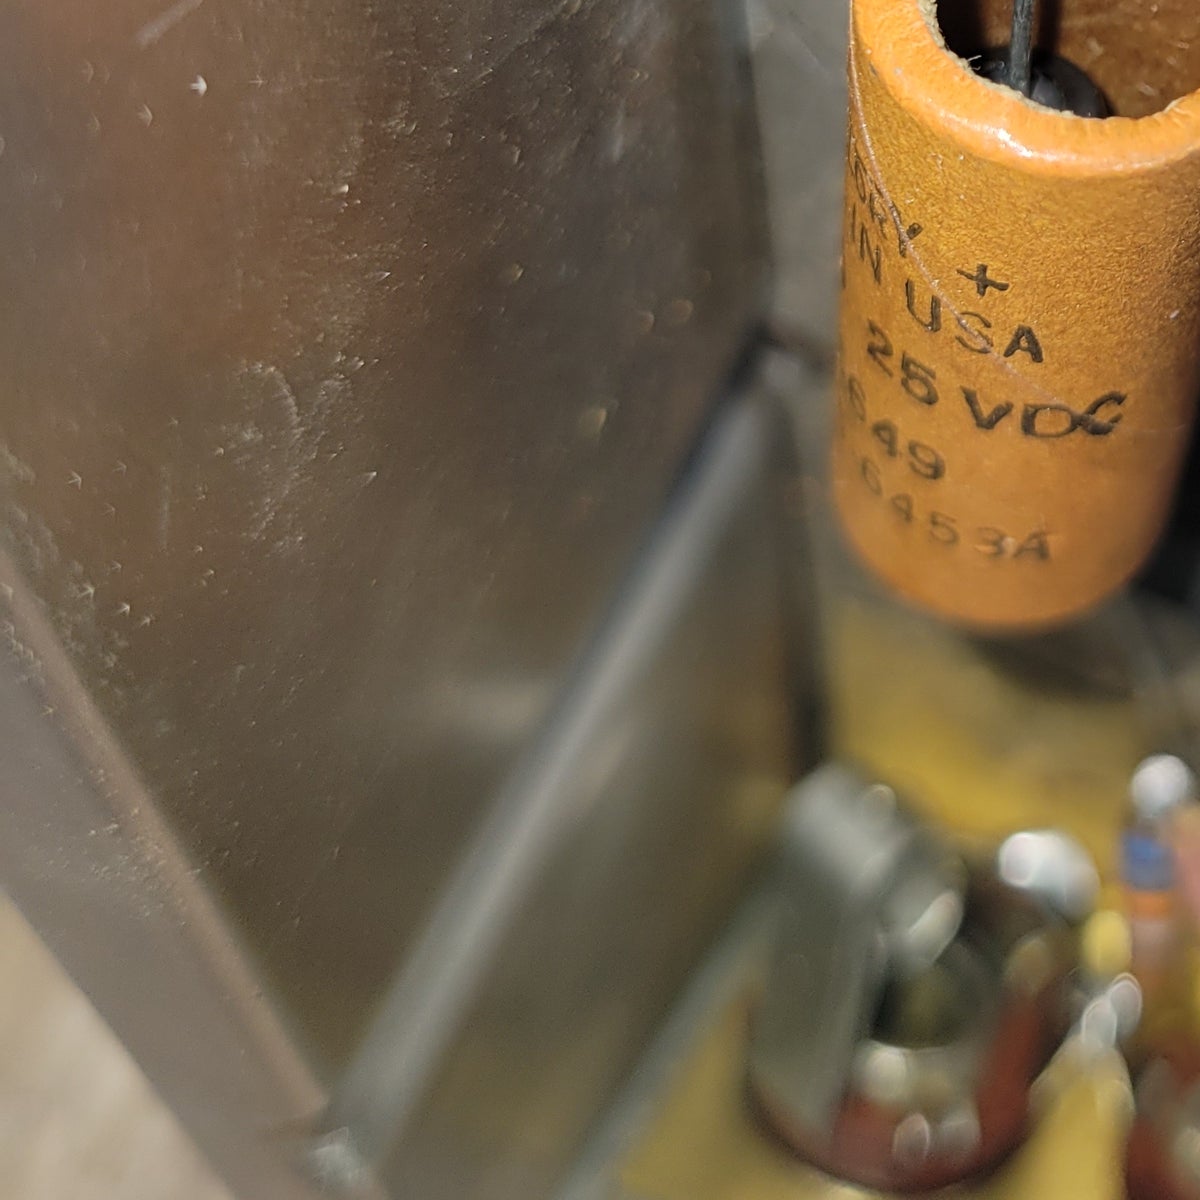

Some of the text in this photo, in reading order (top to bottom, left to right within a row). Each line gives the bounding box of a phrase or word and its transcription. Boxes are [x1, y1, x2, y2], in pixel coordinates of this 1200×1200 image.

[905, 278, 1044, 363] USA
[866, 318, 1128, 438] 25 VDC
